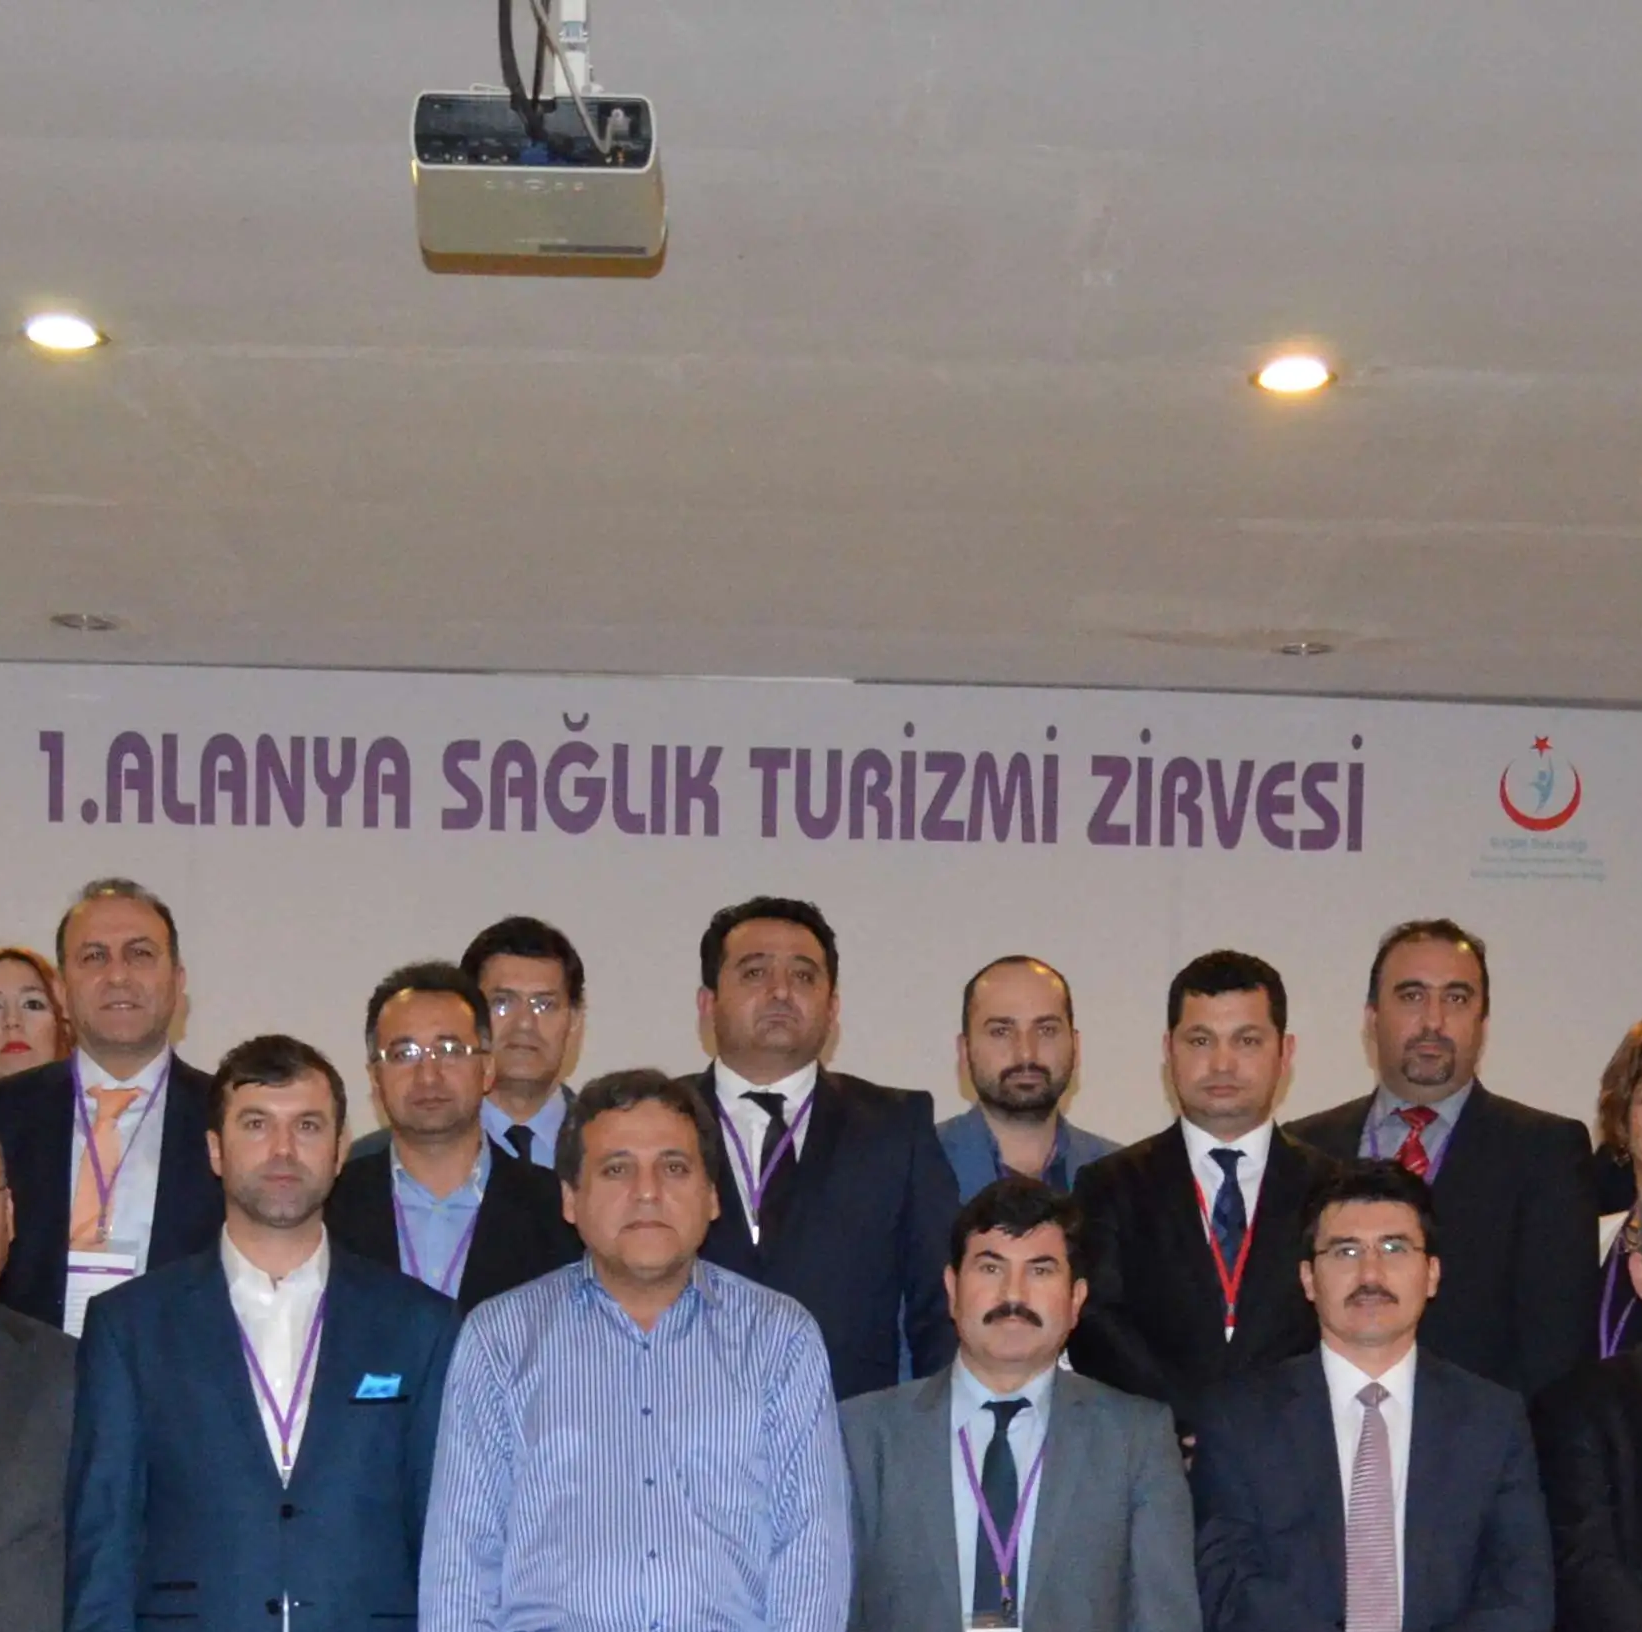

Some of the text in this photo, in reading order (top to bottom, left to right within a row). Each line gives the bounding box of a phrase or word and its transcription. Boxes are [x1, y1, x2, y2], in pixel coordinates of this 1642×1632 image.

[39, 711, 1365, 853] 1.ALANYA SAĞLIK TURİZMİ ZİRVESİ
